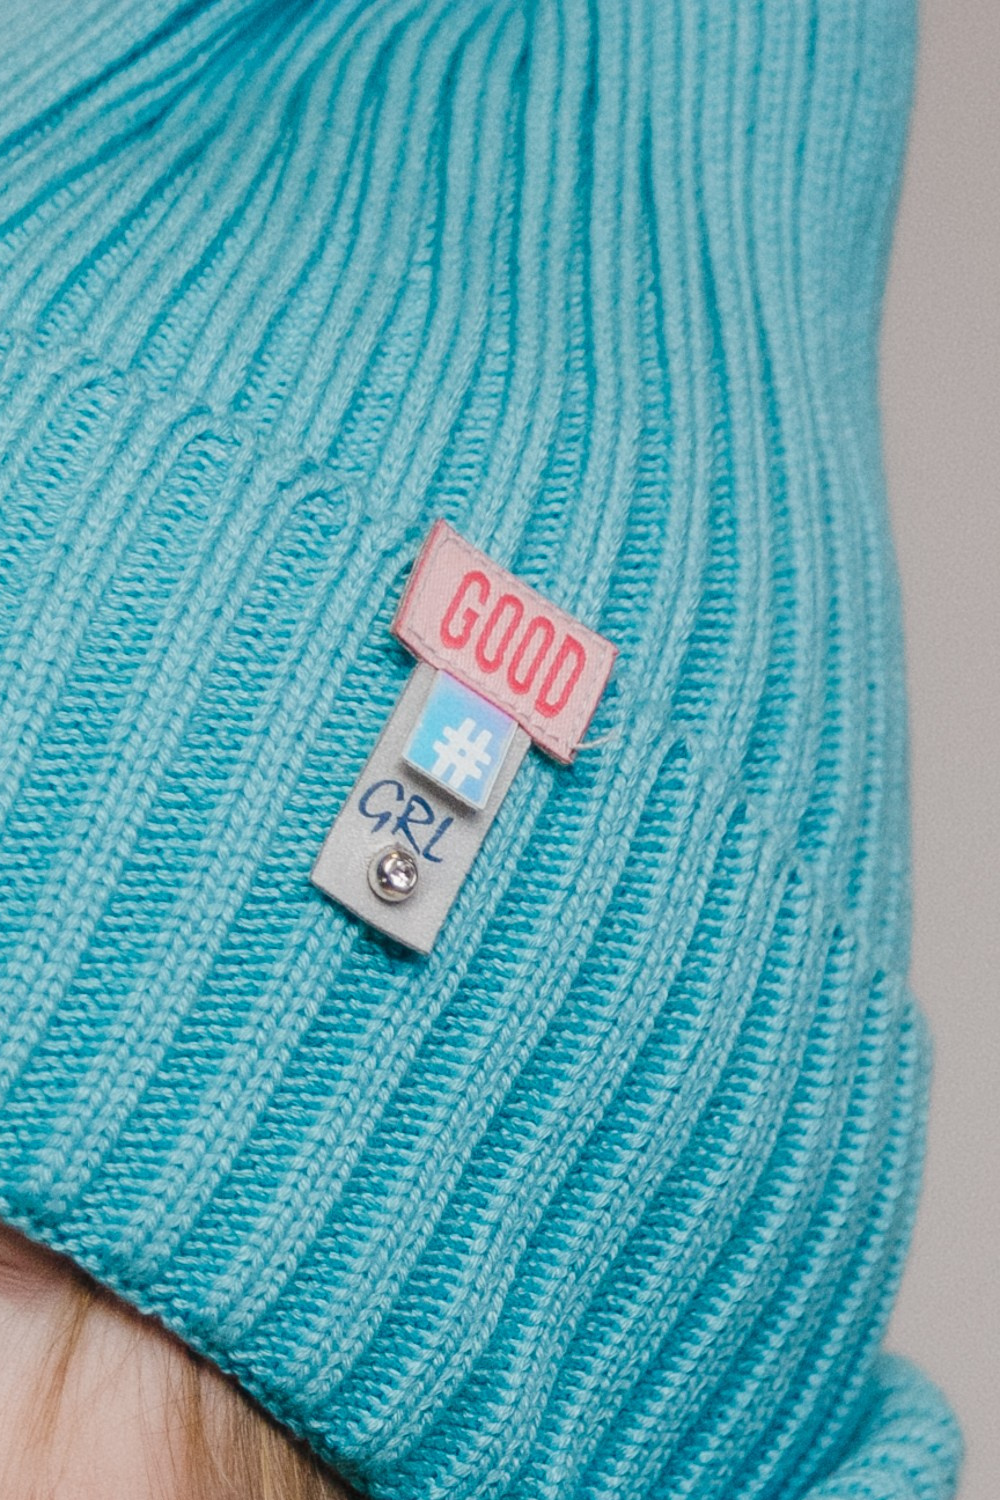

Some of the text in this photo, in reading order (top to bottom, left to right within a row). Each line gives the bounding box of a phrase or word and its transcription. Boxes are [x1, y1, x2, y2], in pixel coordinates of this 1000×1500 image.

[439, 570, 587, 718] GOOD
[431, 718, 493, 787] #
[357, 779, 456, 863] GRL
